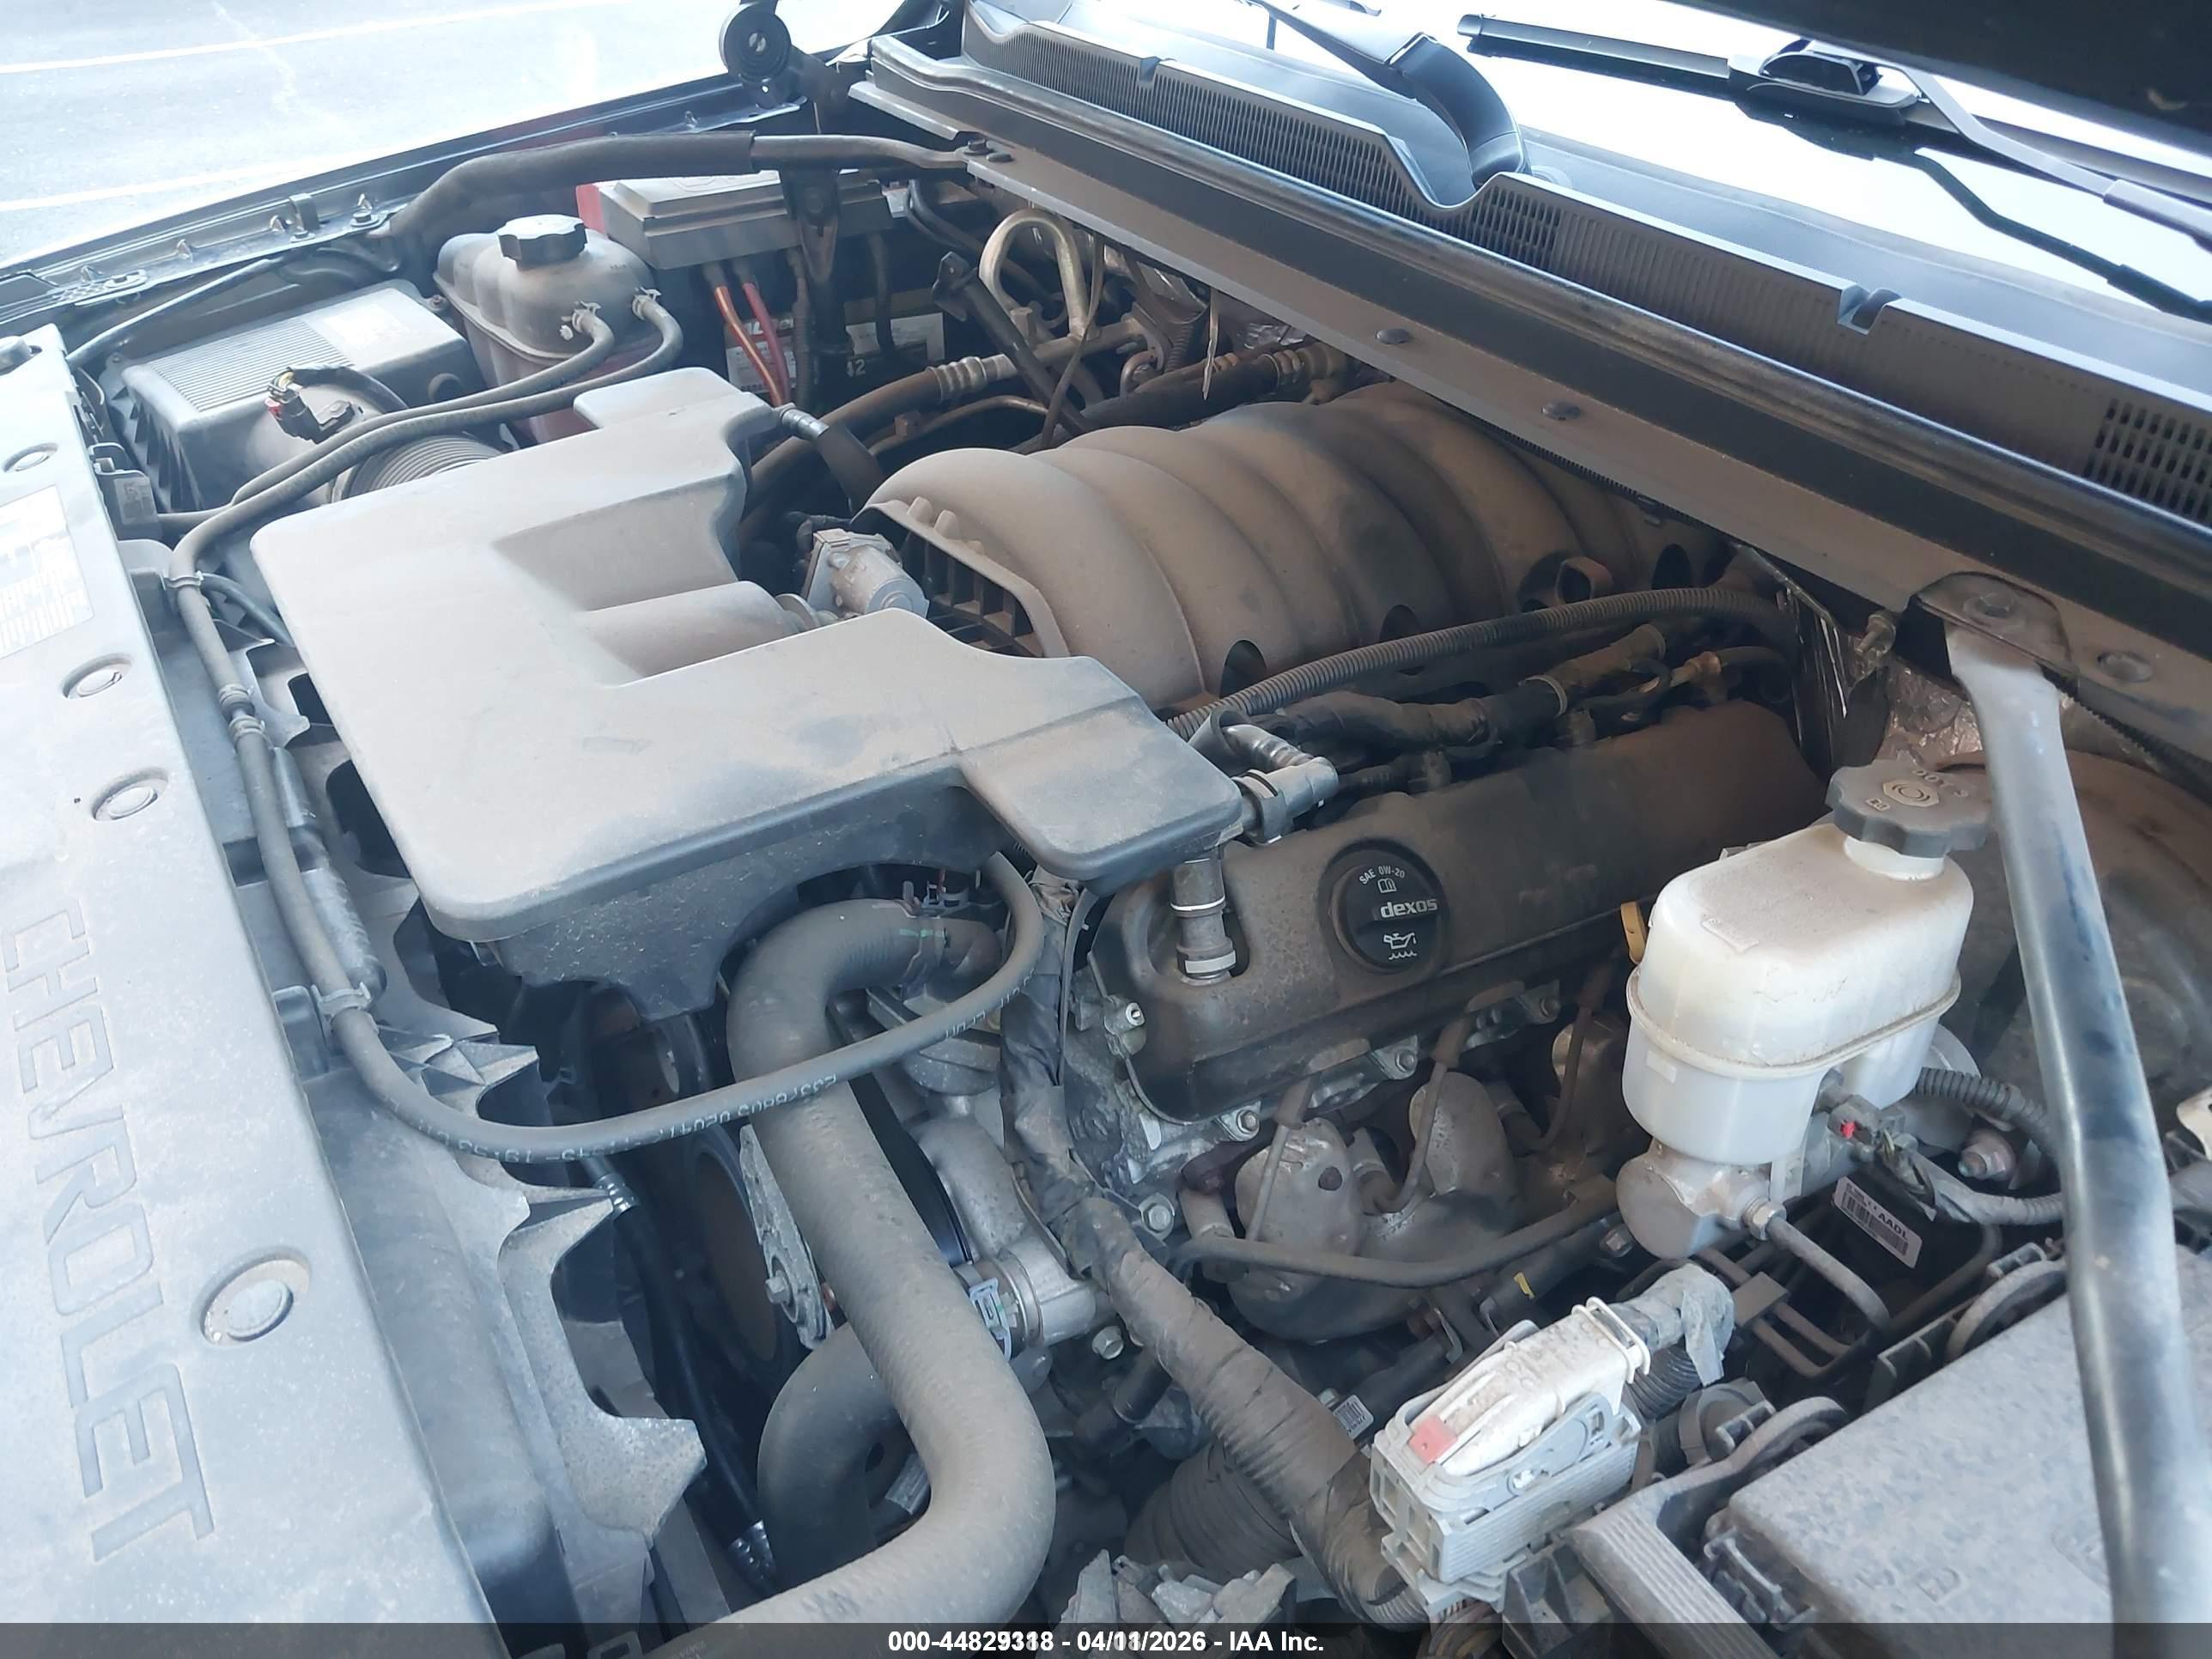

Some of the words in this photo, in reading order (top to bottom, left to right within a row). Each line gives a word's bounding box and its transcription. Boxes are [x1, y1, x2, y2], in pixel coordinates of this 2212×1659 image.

[1358, 868, 1376, 884] SAE
[1378, 865, 1406, 879] 0W-20
[1380, 898, 1438, 918] dexos
[2, 898, 215, 1563] CHEVROLET
